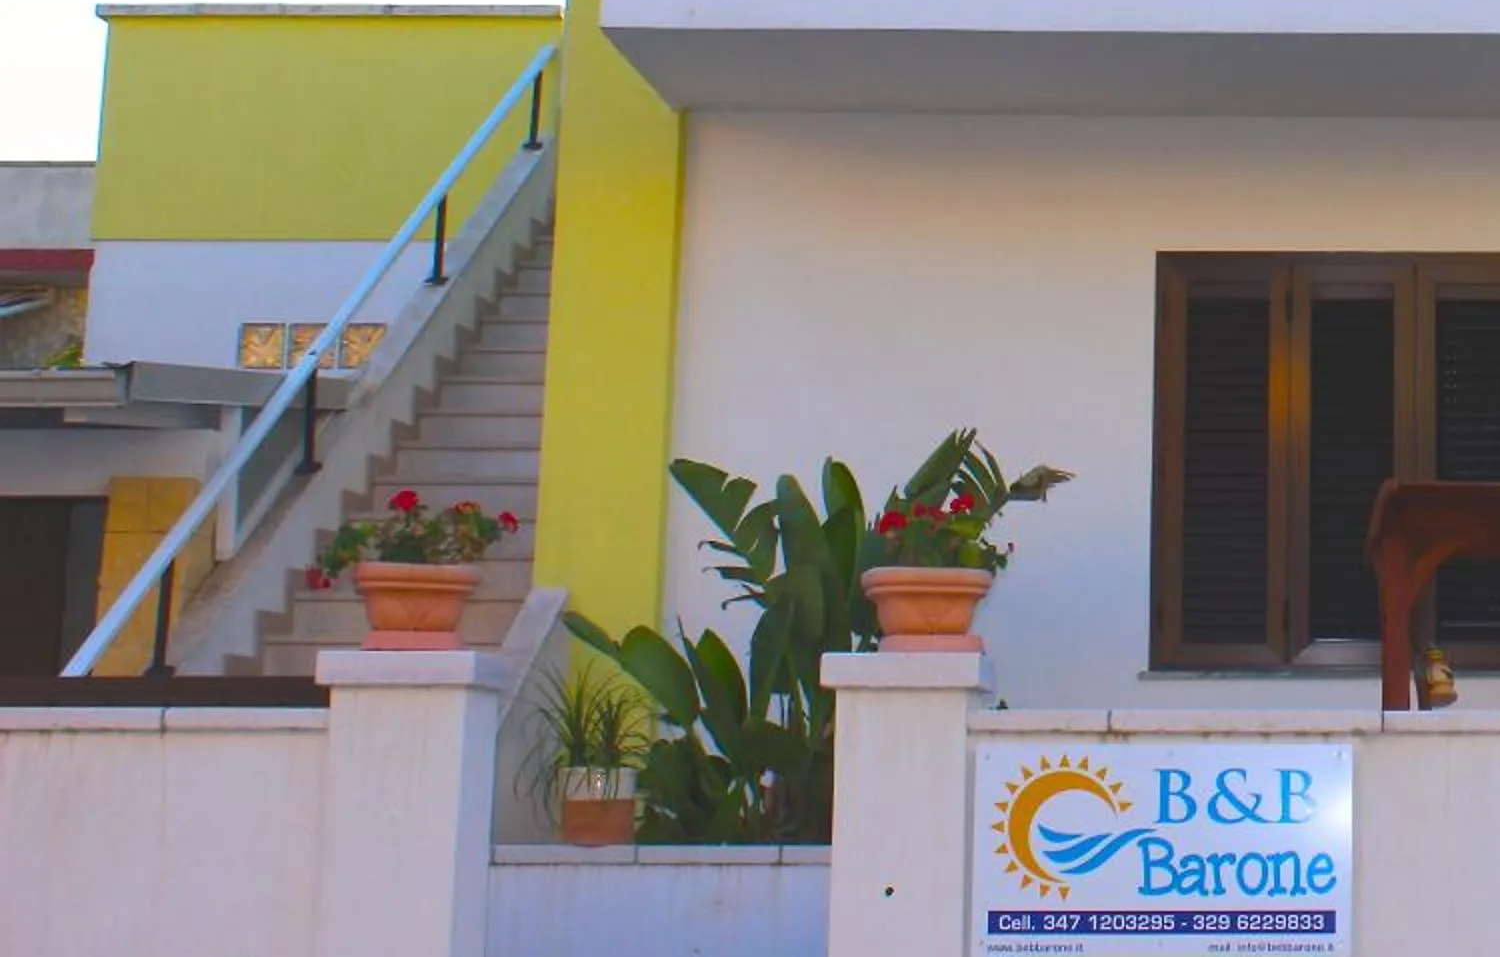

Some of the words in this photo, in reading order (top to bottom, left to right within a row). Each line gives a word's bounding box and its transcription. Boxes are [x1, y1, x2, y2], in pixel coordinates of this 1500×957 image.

[1137, 837, 1337, 897] Barone
[999, 915, 1035, 931] Cell.
[1043, 915, 1080, 930] 347
[1088, 915, 1175, 930] 1203295
[1193, 915, 1230, 930] 329
[1237, 915, 1324, 930] 6229833
